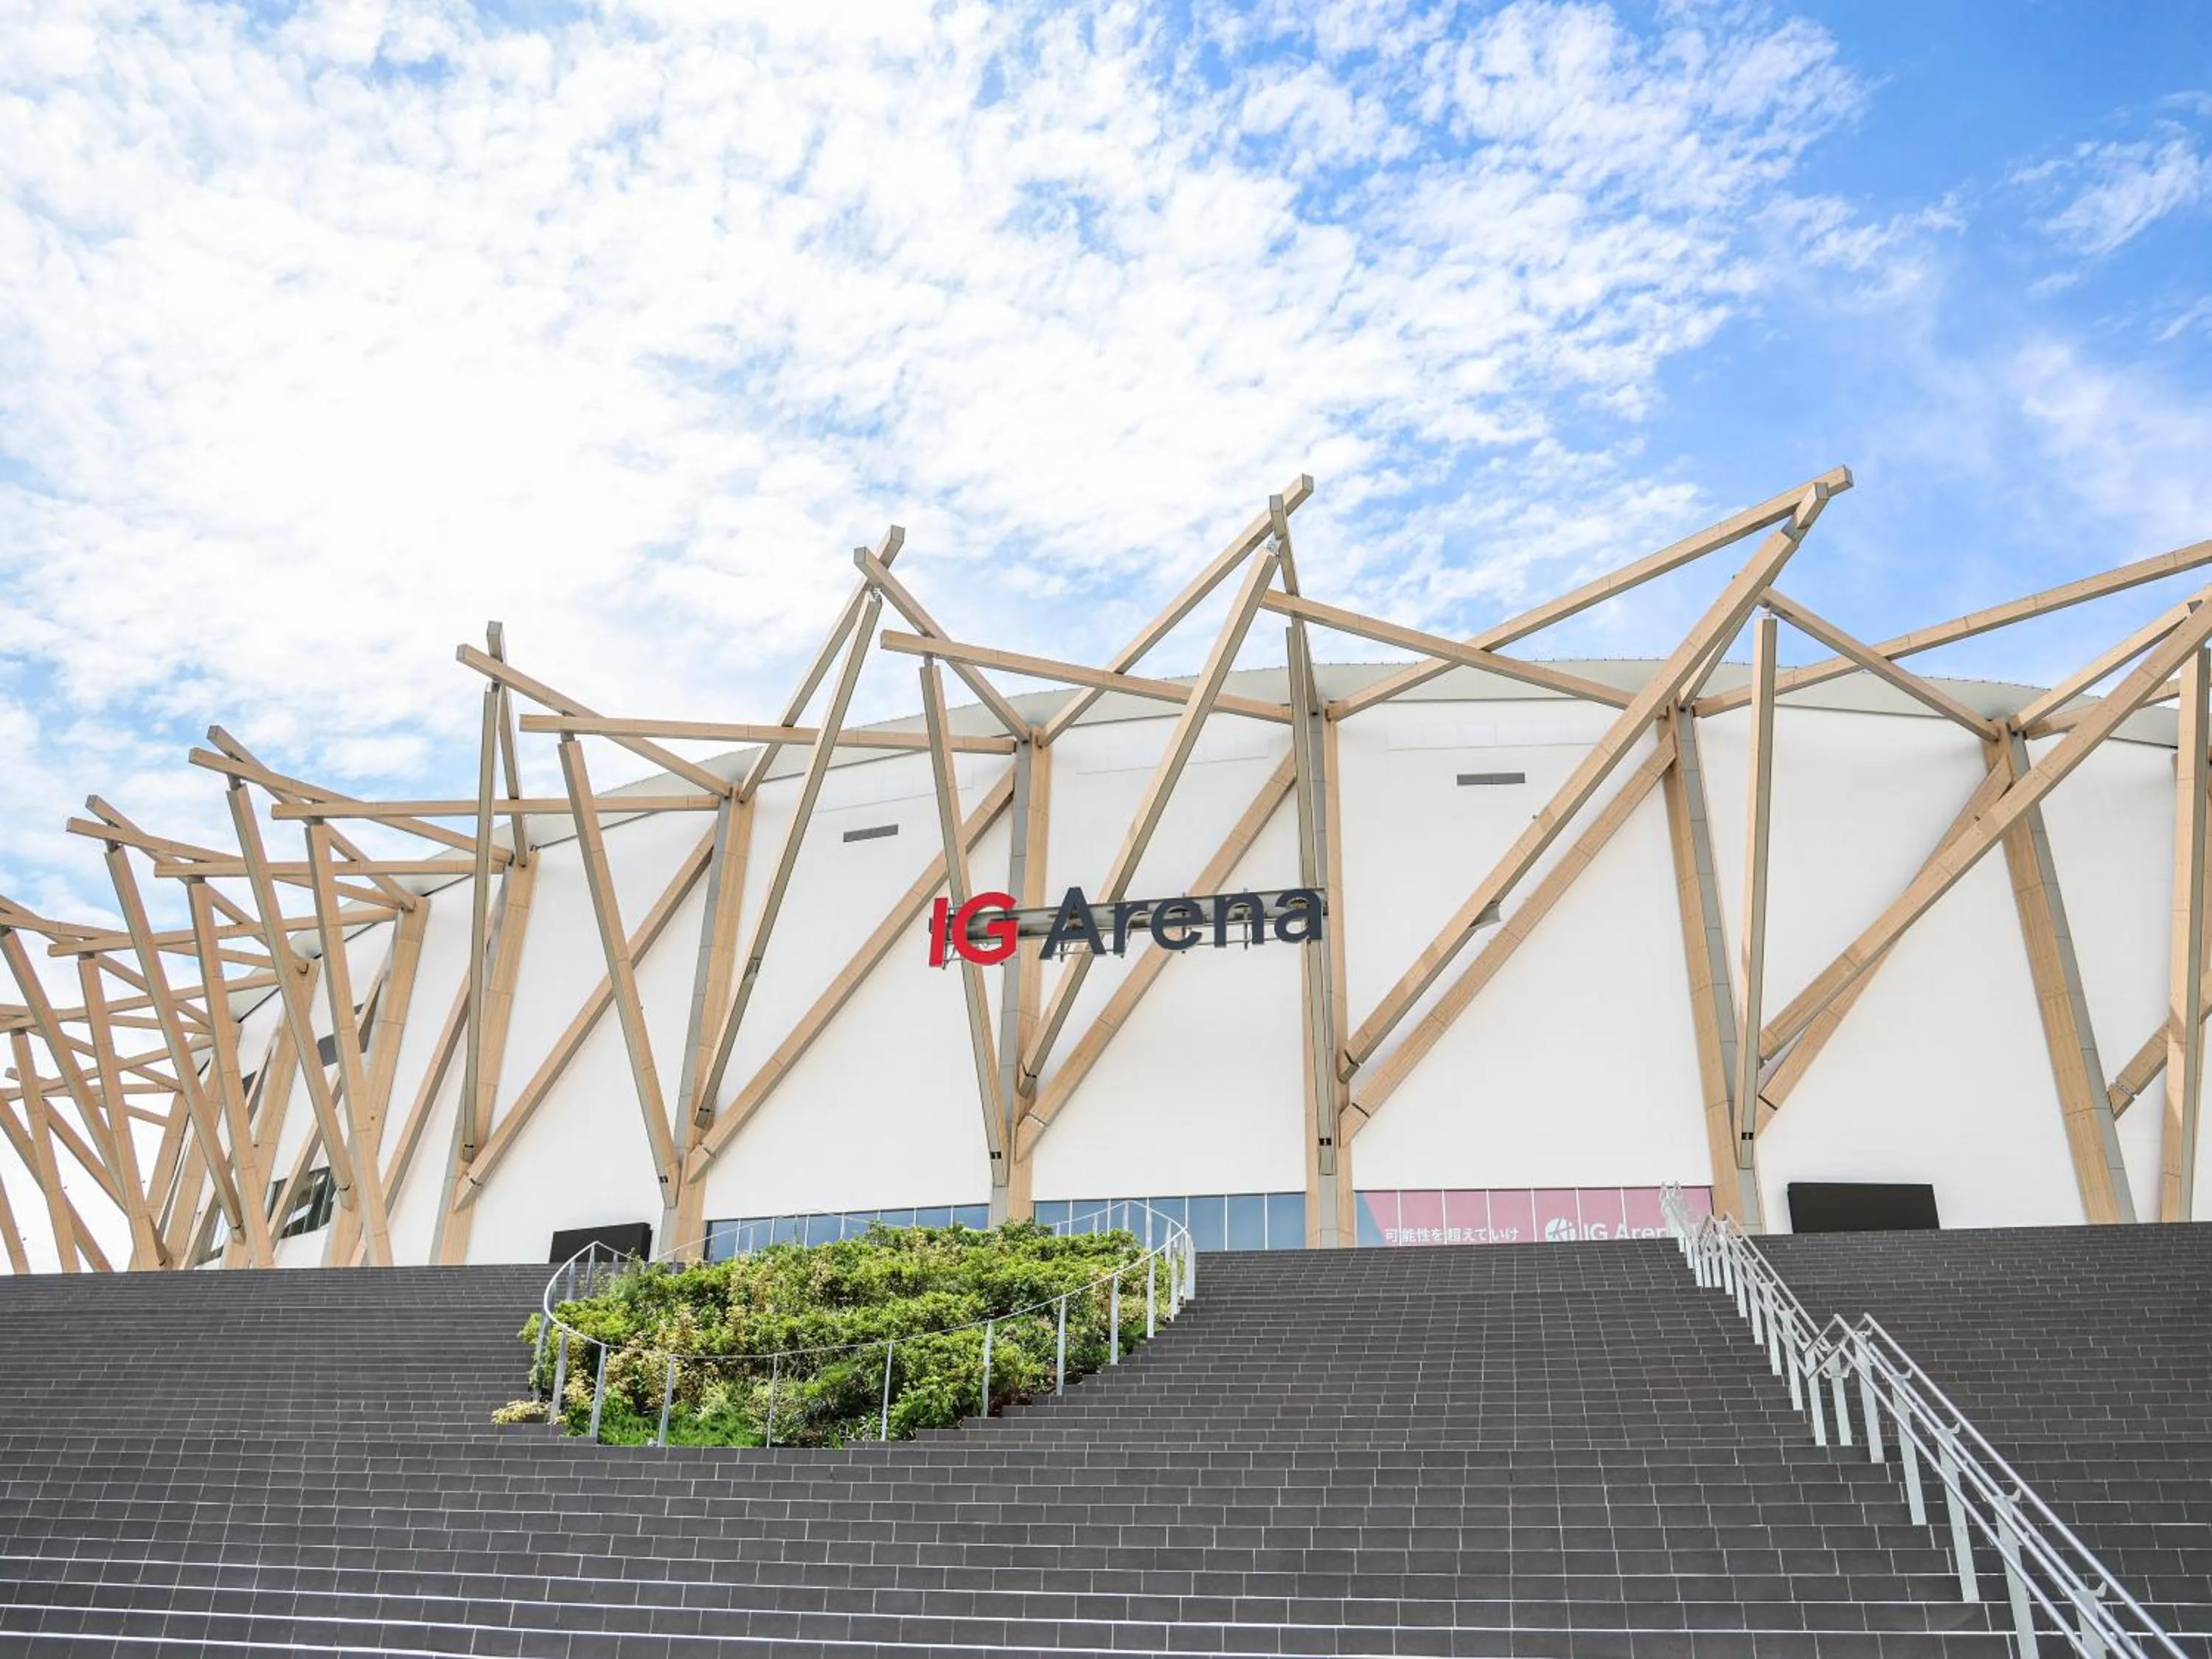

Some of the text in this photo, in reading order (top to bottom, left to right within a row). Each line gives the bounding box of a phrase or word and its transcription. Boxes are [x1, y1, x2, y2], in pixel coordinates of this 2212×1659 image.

[929, 886, 1322, 967] IG Arena
[1384, 1227, 1520, 1242] 可能性を超えていけ
[1584, 1222, 1671, 1241] IG Aren
